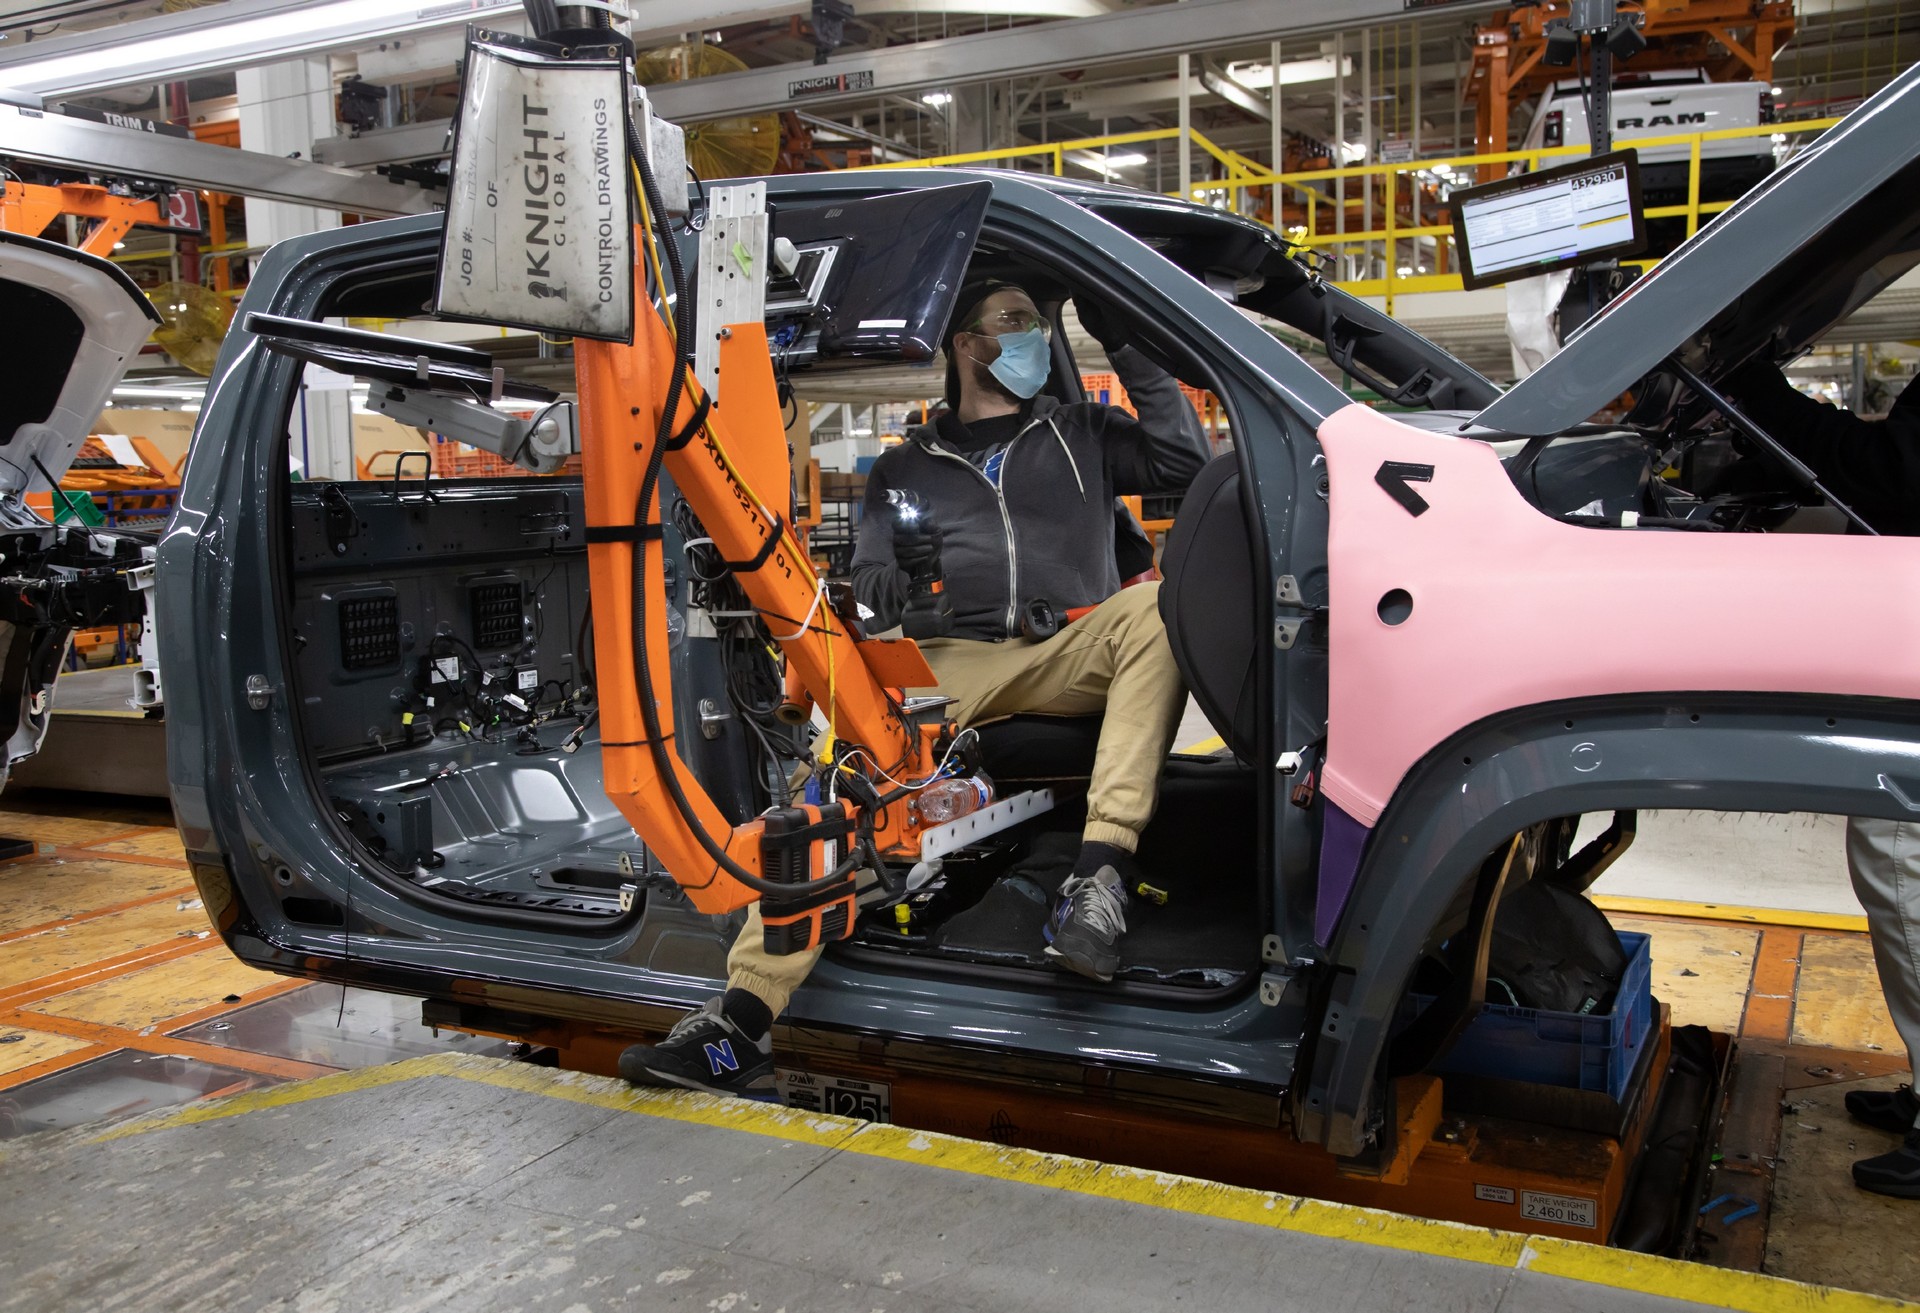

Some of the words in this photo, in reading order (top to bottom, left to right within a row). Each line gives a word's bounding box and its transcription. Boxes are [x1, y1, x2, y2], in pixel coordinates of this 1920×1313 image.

[795, 76, 838, 90] KNIGHT
[103, 112, 142, 131] TRIM
[147, 120, 156, 133] 4
[1617, 112, 1705, 129] RAM
[594, 98, 612, 205] DRAWINGS
[486, 180, 498, 208] OF
[523, 94, 550, 277] KNIGHT
[553, 131, 566, 246] GLOBAL
[1572, 172, 1616, 190] 432930
[460, 248, 473, 286] JOB
[599, 210, 613, 303] CONTROL
[703, 1038, 740, 1076] N
[829, 1091, 878, 1122] 125
[1482, 1187, 1508, 1195] CAPACITY
[1529, 1195, 1551, 1206] TARE
[1553, 1199, 1589, 1210] WEIGHT
[1567, 1209, 1590, 1224] lbs.
